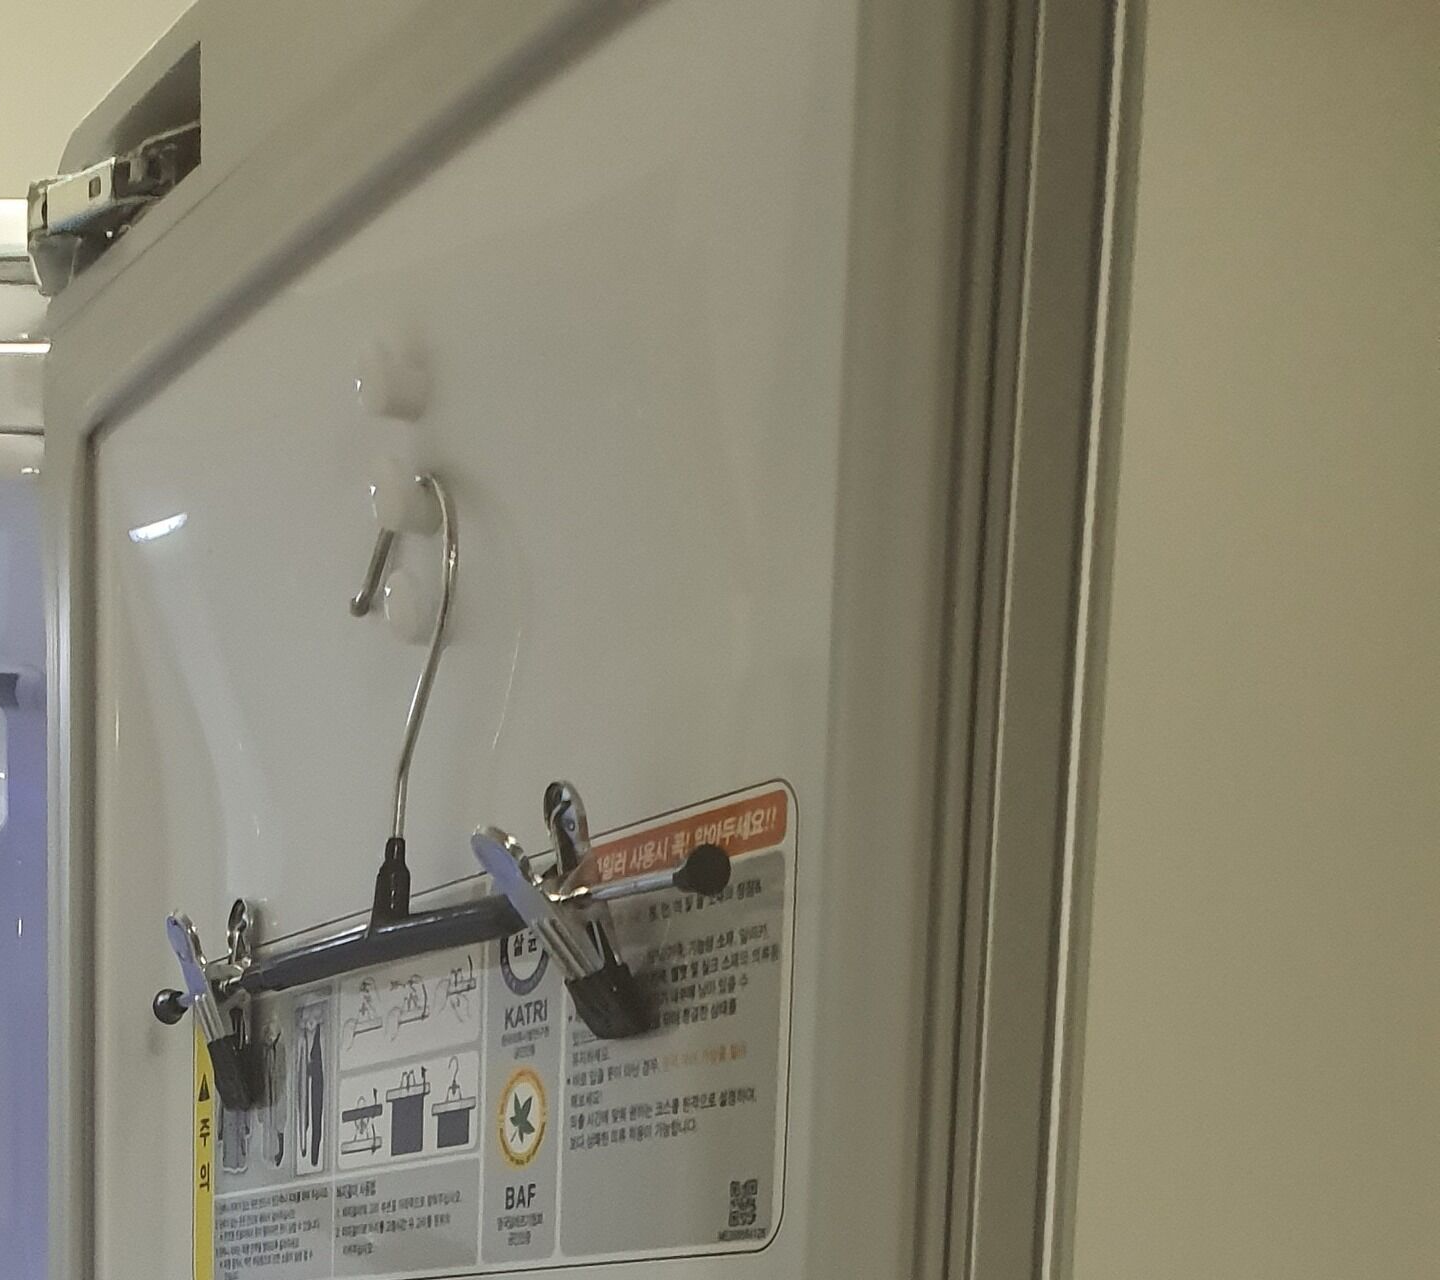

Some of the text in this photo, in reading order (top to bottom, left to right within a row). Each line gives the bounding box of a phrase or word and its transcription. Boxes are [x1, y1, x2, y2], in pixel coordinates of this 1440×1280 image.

[629, 841, 669, 870] 사용시
[504, 998, 548, 1031] KATRI
[505, 1183, 537, 1210] BAF
